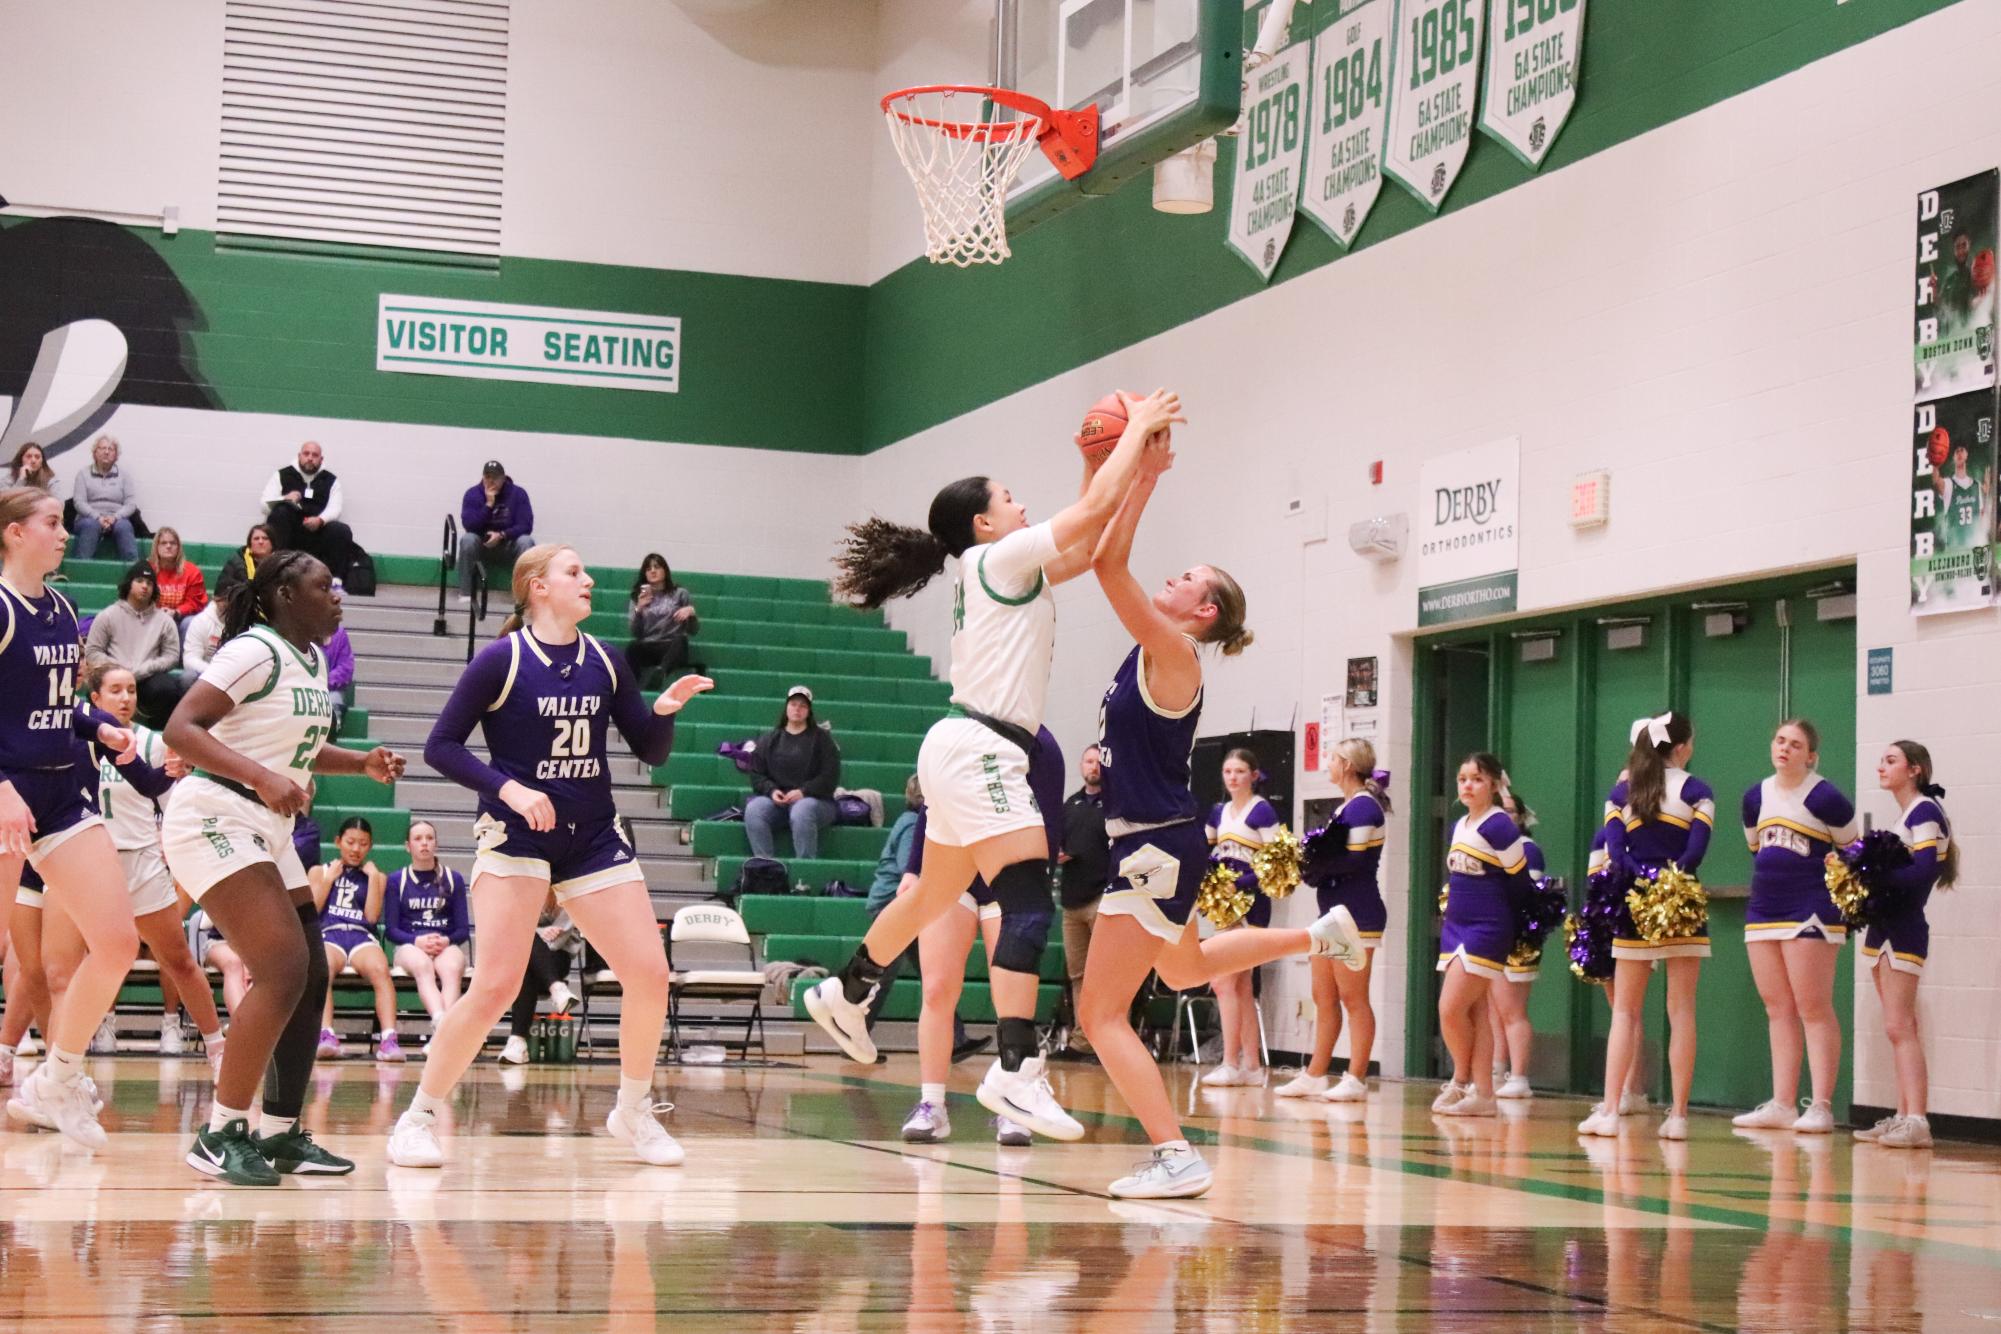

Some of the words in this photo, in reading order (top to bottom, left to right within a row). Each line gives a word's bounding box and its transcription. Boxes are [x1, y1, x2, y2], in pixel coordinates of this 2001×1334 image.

[1410, 0, 1474, 91] 1985
[1515, 48, 1529, 81] 6A
[1532, 31, 1564, 74] STATE
[1323, 37, 1382, 135] 1984
[1418, 97, 1432, 128] 6A
[1433, 82, 1462, 121] STATE
[1507, 61, 1572, 116] CHAMPIONS
[1245, 82, 1299, 172] 1978
[1331, 141, 1344, 169] 6A
[1345, 126, 1370, 161] STATE
[1410, 111, 1468, 162] CHAMPIONS
[1266, 167, 1289, 199] STATE
[1323, 154, 1377, 201] CHAMPIONS
[1247, 192, 1293, 236] CHAMPIONS
[386, 319, 508, 357] VISITOR
[544, 331, 674, 369] SEATING
[1435, 478, 1502, 526] DERBY
[1959, 506, 1972, 526] 33
[1422, 525, 1513, 556] ORTHODONTICS
[33, 643, 80, 666] VALLEY
[48, 667, 74, 706] 14
[291, 687, 331, 718] DERB
[537, 696, 600, 716] VALLEY
[27, 708, 73, 730] CENT
[551, 719, 590, 757] 20
[536, 757, 600, 779] CENTER
[336, 888, 354, 909] 12
[684, 914, 735, 927] DERBY
